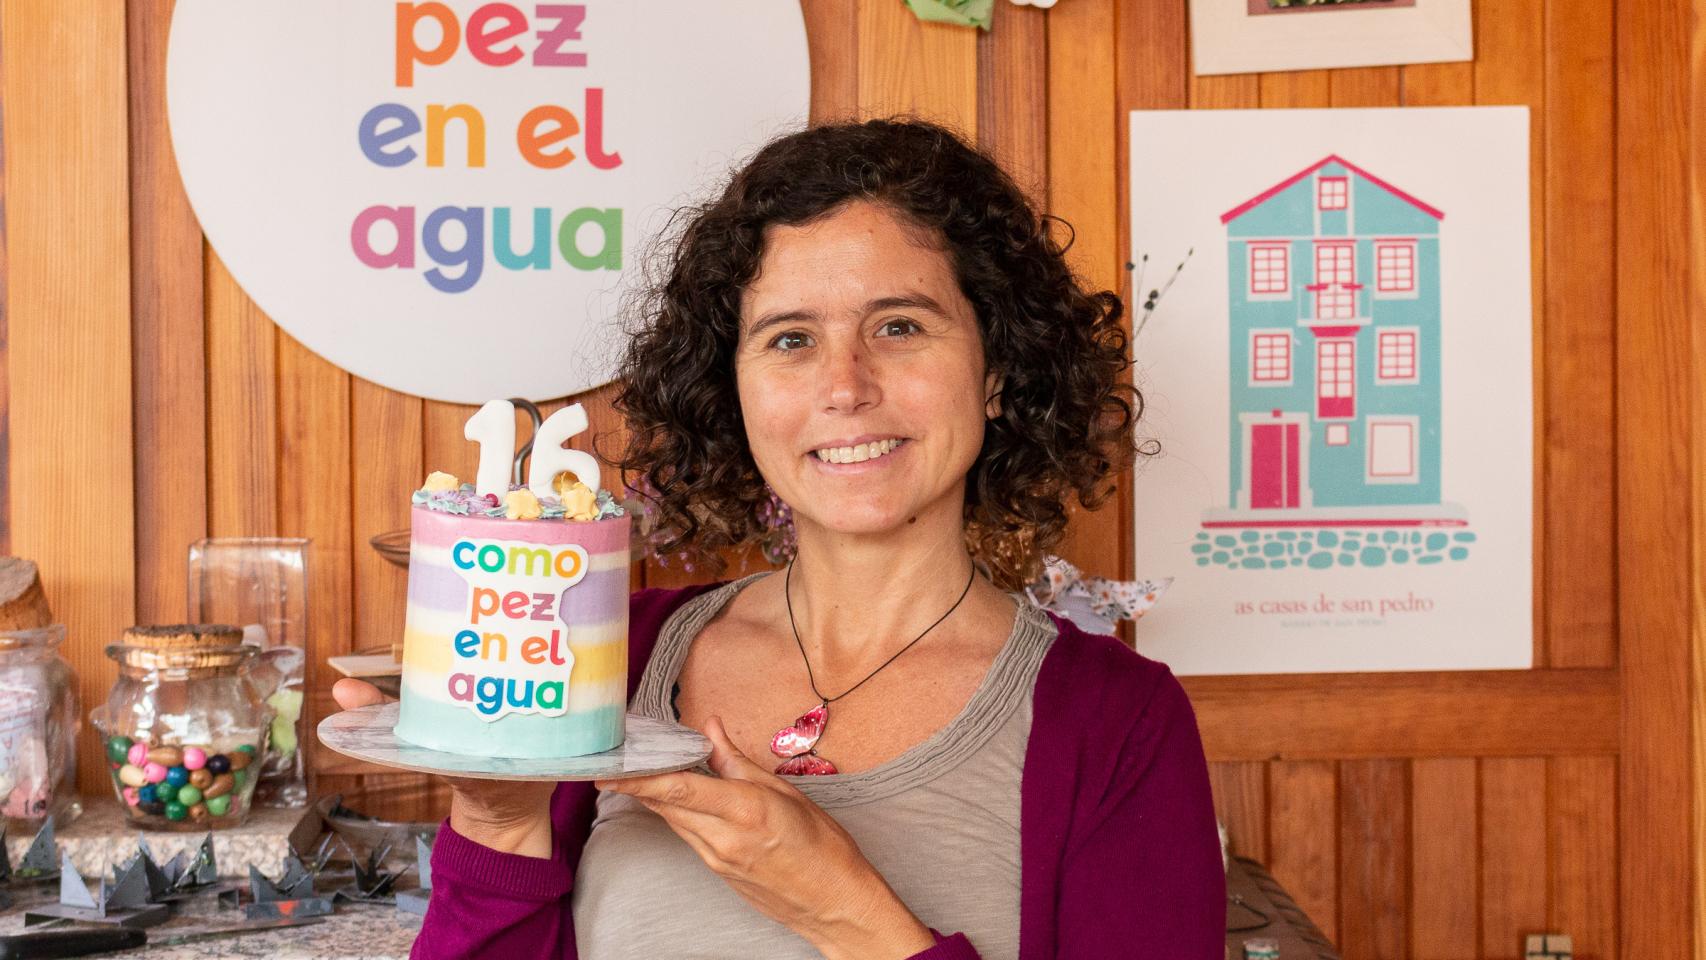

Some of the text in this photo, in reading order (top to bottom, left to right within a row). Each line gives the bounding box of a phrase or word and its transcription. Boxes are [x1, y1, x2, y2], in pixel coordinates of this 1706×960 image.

[395, 2, 587, 87] pez
[358, 88, 623, 170] en el
[351, 205, 623, 293] agua
[464, 400, 600, 503] 16
[453, 541, 582, 578] como
[470, 586, 556, 625] pez
[1235, 591, 1435, 617] as casas de san pedro
[454, 629, 566, 666] en el
[448, 672, 565, 715] agua
